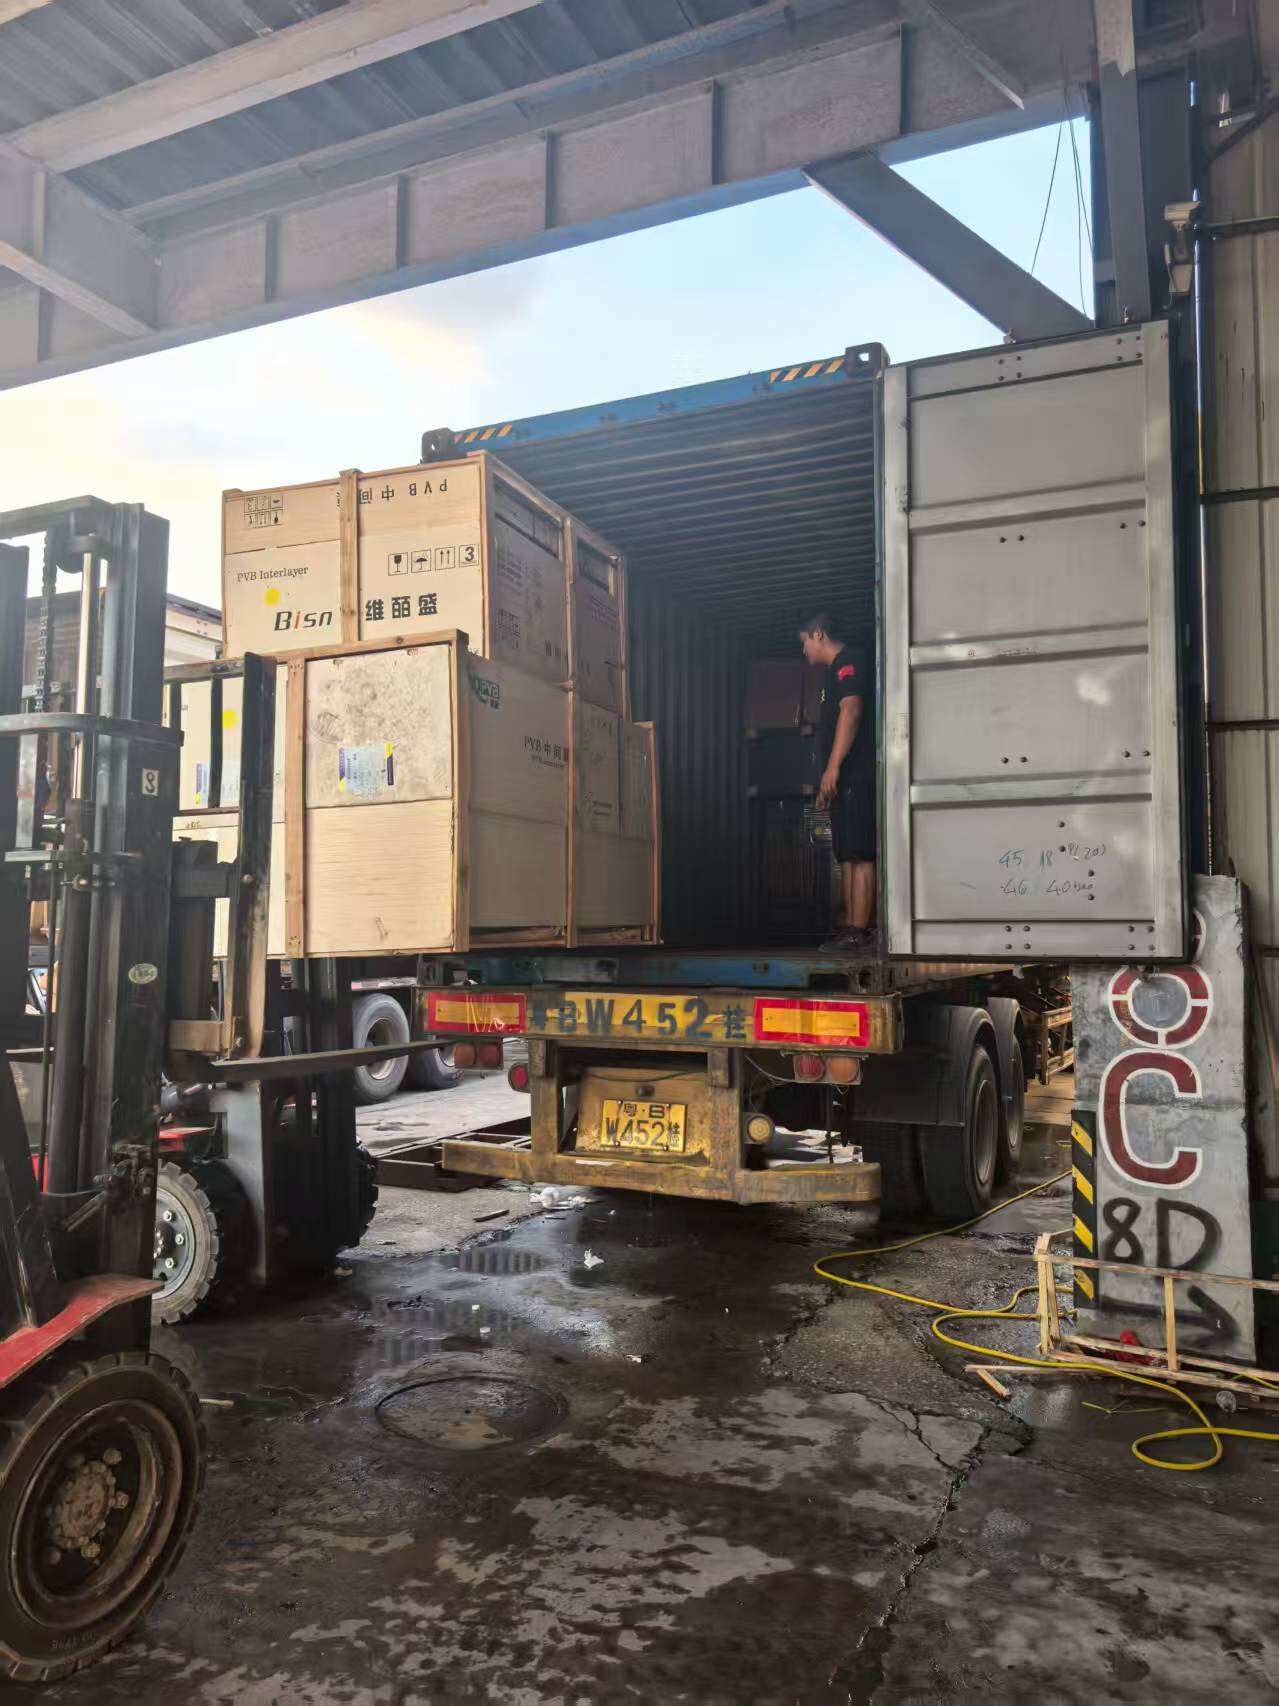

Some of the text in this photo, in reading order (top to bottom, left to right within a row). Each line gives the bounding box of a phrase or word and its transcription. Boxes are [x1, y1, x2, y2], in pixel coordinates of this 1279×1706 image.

[409, 478, 448, 497] PVB
[465, 547, 475, 562] 3
[237, 566, 309, 582] PVB Interlayer
[273, 611, 333, 631] Bisn
[1103, 1197, 1222, 1272] 8D
